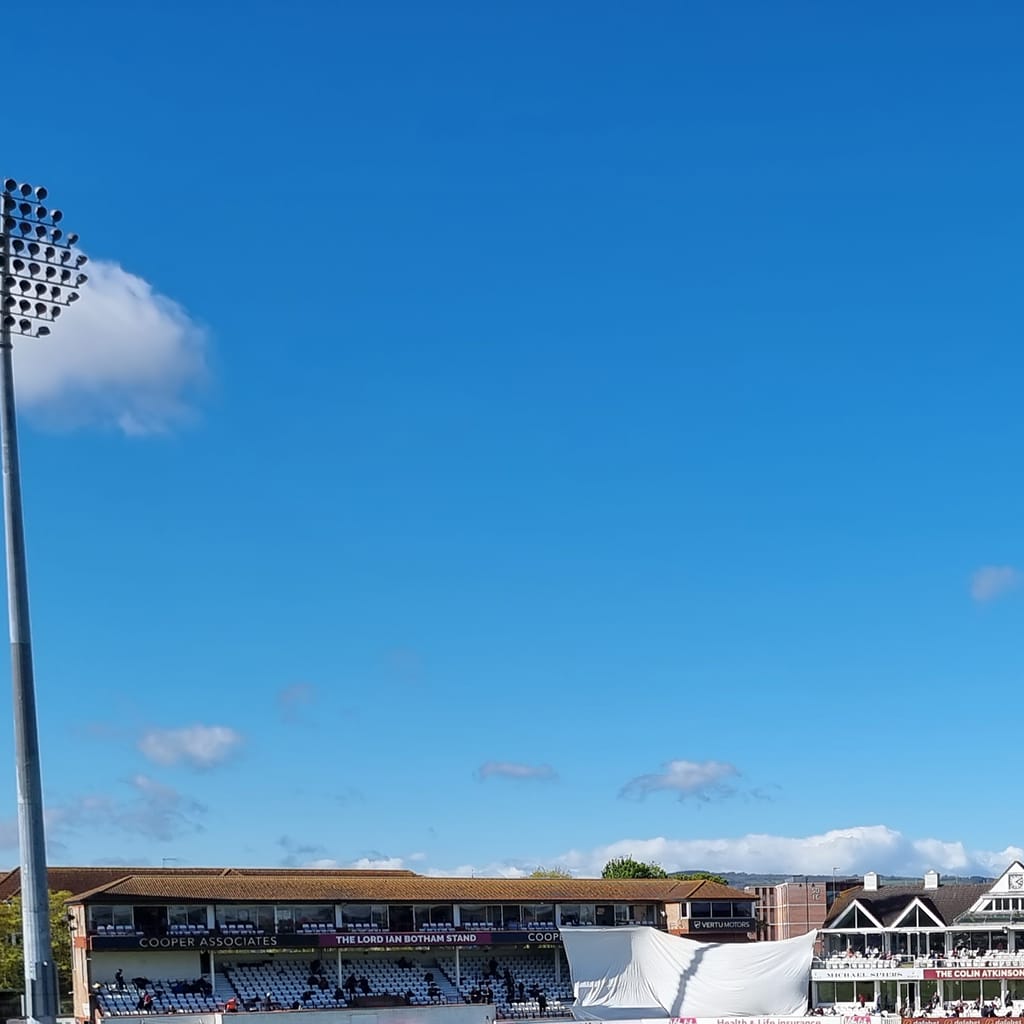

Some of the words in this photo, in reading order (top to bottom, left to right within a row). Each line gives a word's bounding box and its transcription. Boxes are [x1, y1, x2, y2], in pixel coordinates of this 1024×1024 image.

[139, 937, 196, 948] COOPER
[199, 936, 278, 947] ASSOCIATES
[336, 936, 355, 944] THE
[357, 935, 384, 944] LORD
[385, 935, 402, 943] IAN
[403, 934, 445, 943] BOTHAM
[446, 933, 477, 942] STAND
[936, 970, 952, 978] THE
[953, 969, 979, 977] COLIN
